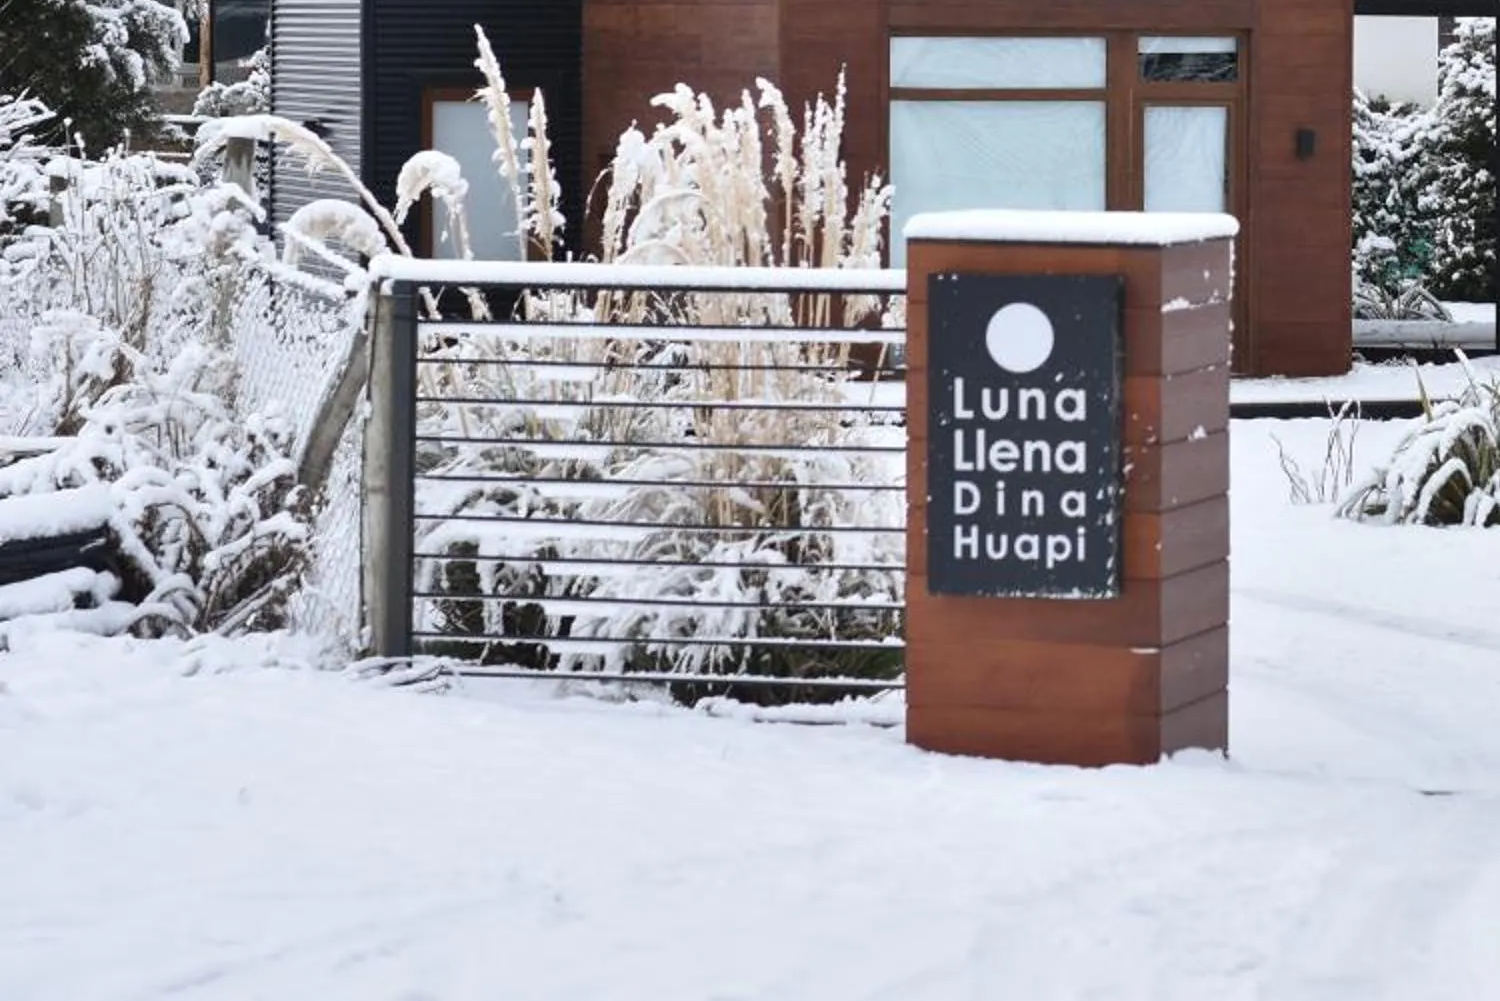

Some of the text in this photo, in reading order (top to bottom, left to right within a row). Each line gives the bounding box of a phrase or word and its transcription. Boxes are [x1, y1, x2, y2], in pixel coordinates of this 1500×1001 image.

[954, 428, 1087, 474] Llena
[954, 479, 1087, 518] Dina
[954, 524, 1086, 569] Huapi
